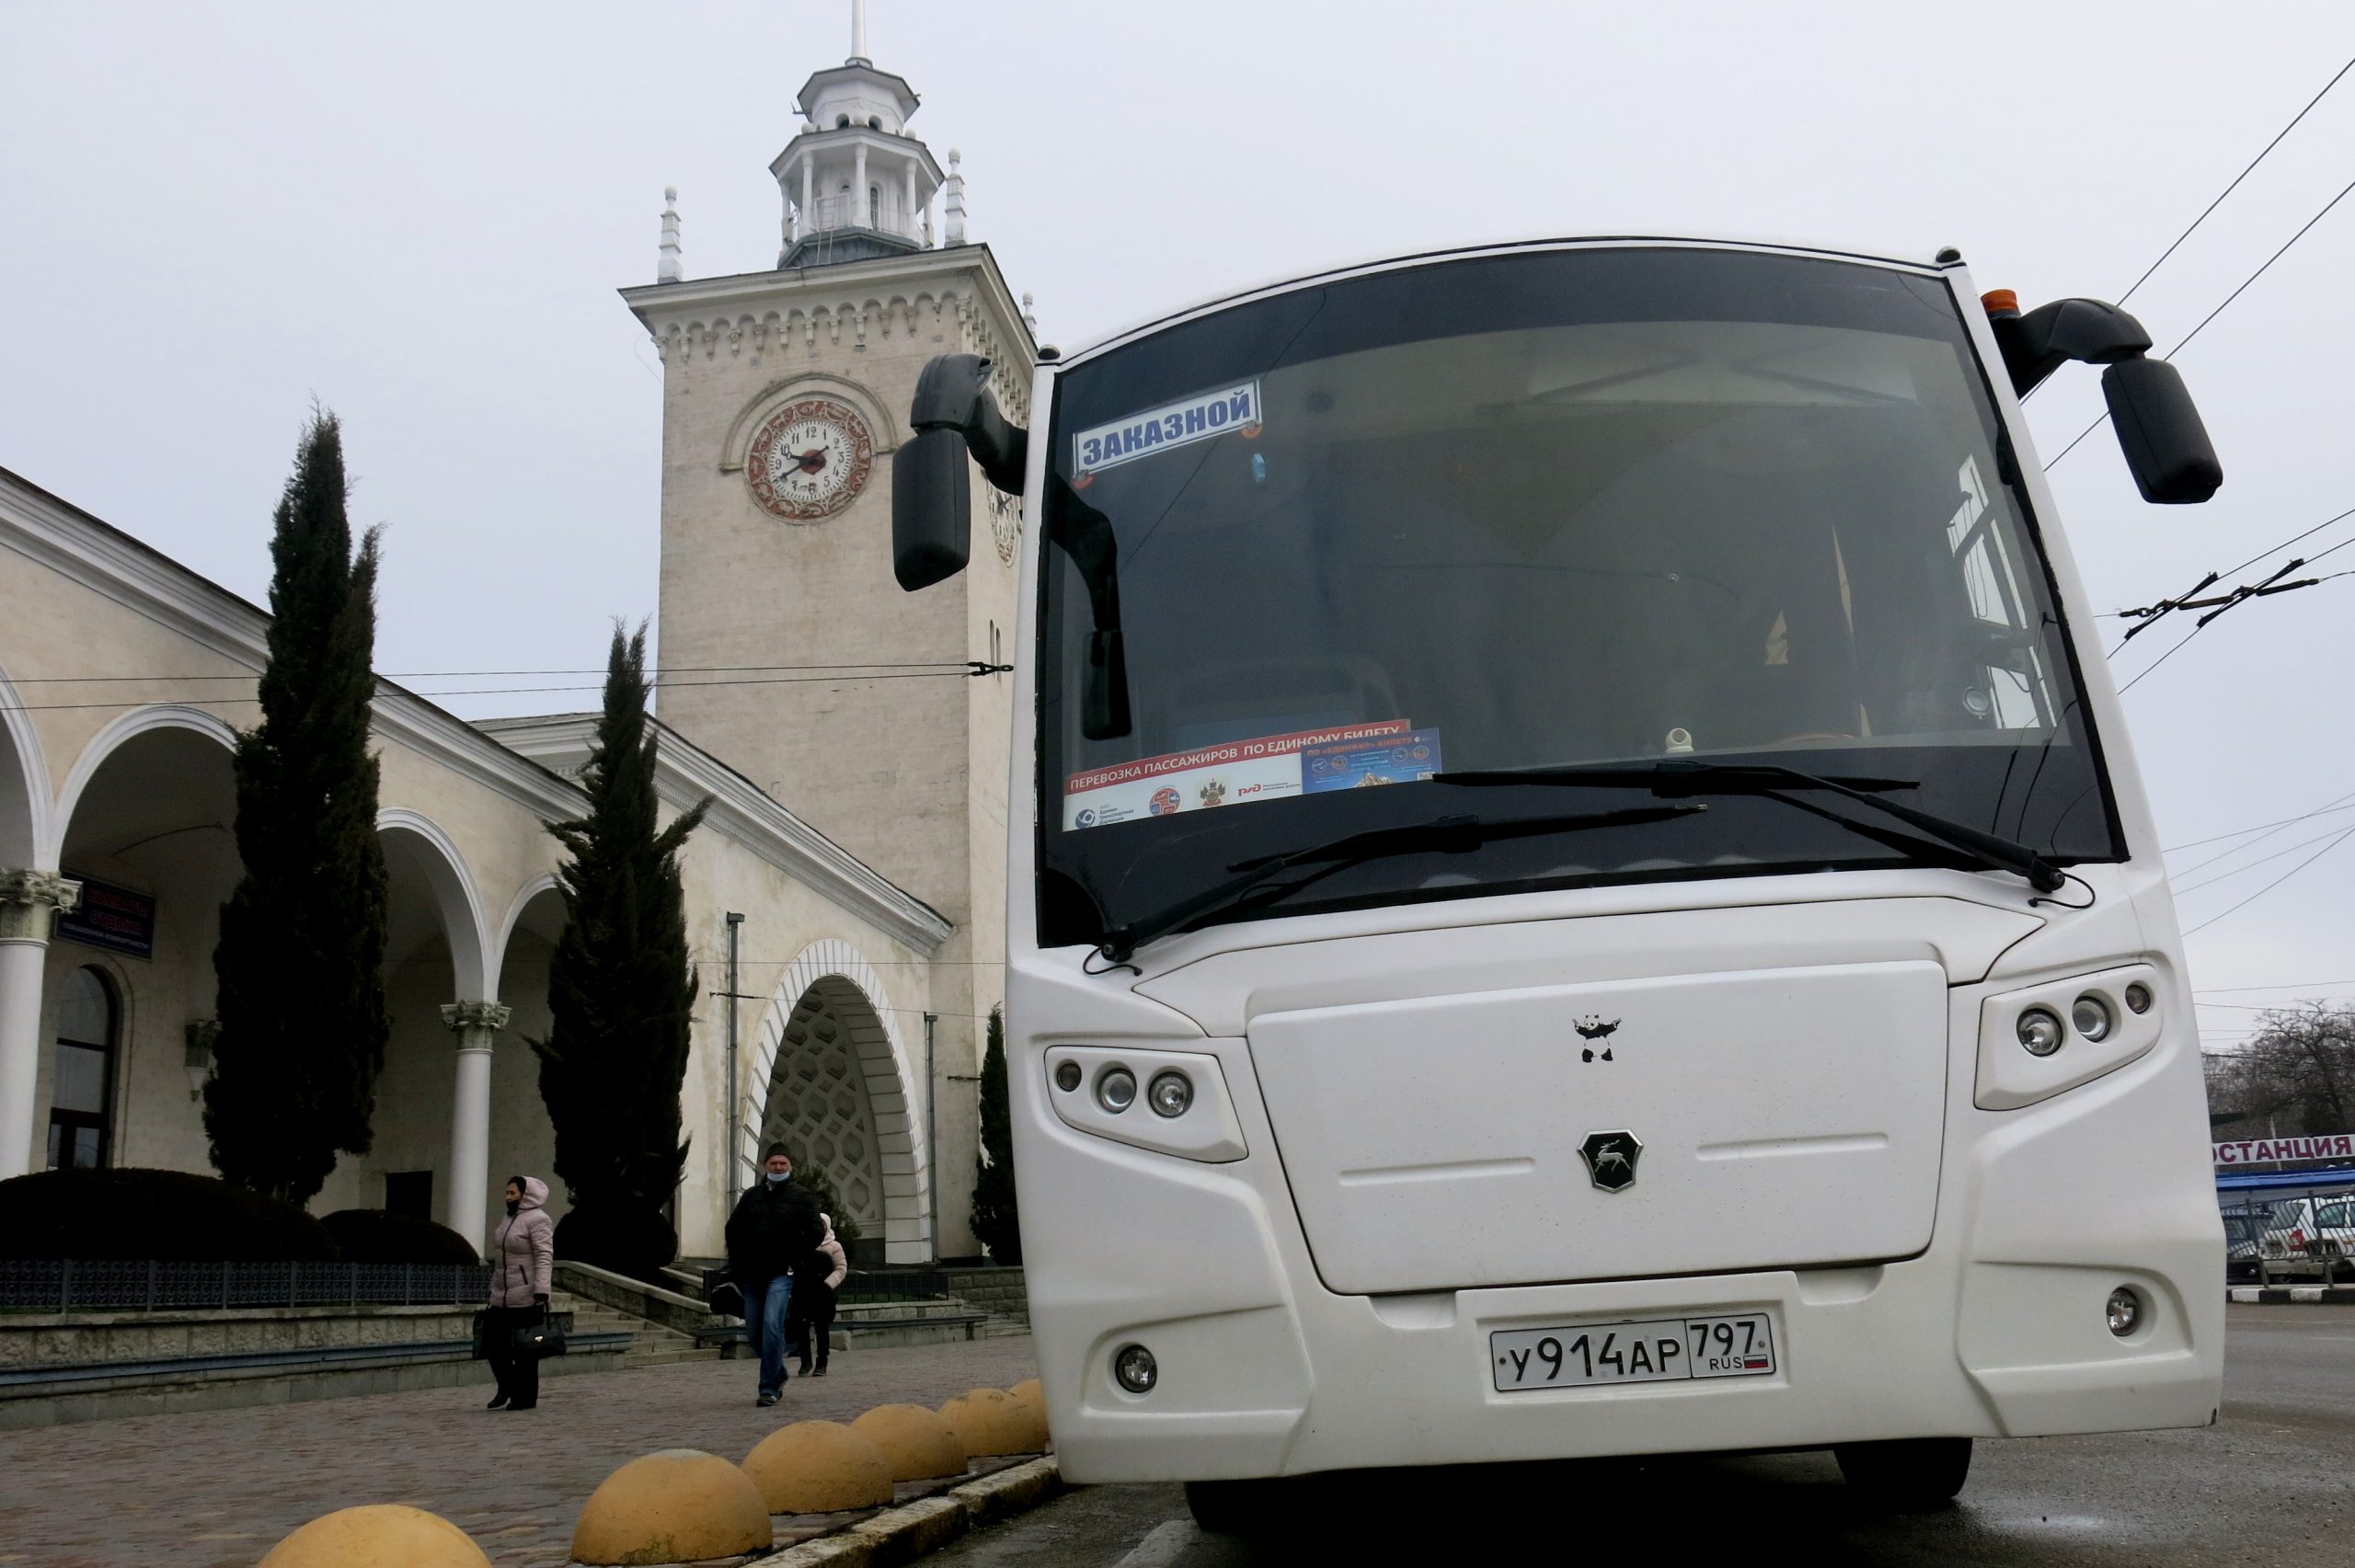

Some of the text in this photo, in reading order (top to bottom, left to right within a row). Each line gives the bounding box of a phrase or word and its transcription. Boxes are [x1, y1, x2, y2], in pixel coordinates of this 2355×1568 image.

[806, 426, 817, 439] 12
[1083, 389, 1250, 466] ЗАКАЗНОЙ
[791, 432, 799, 444] 11
[822, 429, 827, 440] 1
[833, 437, 840, 449] 2
[838, 452, 844, 463] 3
[775, 459, 782, 470] 9
[832, 466, 840, 477] 4
[791, 480, 798, 492] 7
[823, 475, 831, 487] 5
[808, 482, 817, 496] 6
[1070, 765, 1142, 791] ПЕРЕВОЗКА
[1143, 747, 1238, 774] ПАССАЖИРОВ
[1244, 743, 1265, 756] ПО
[1510, 1321, 1756, 1382] У914АР 797
[1709, 1356, 1742, 1371] RUS
